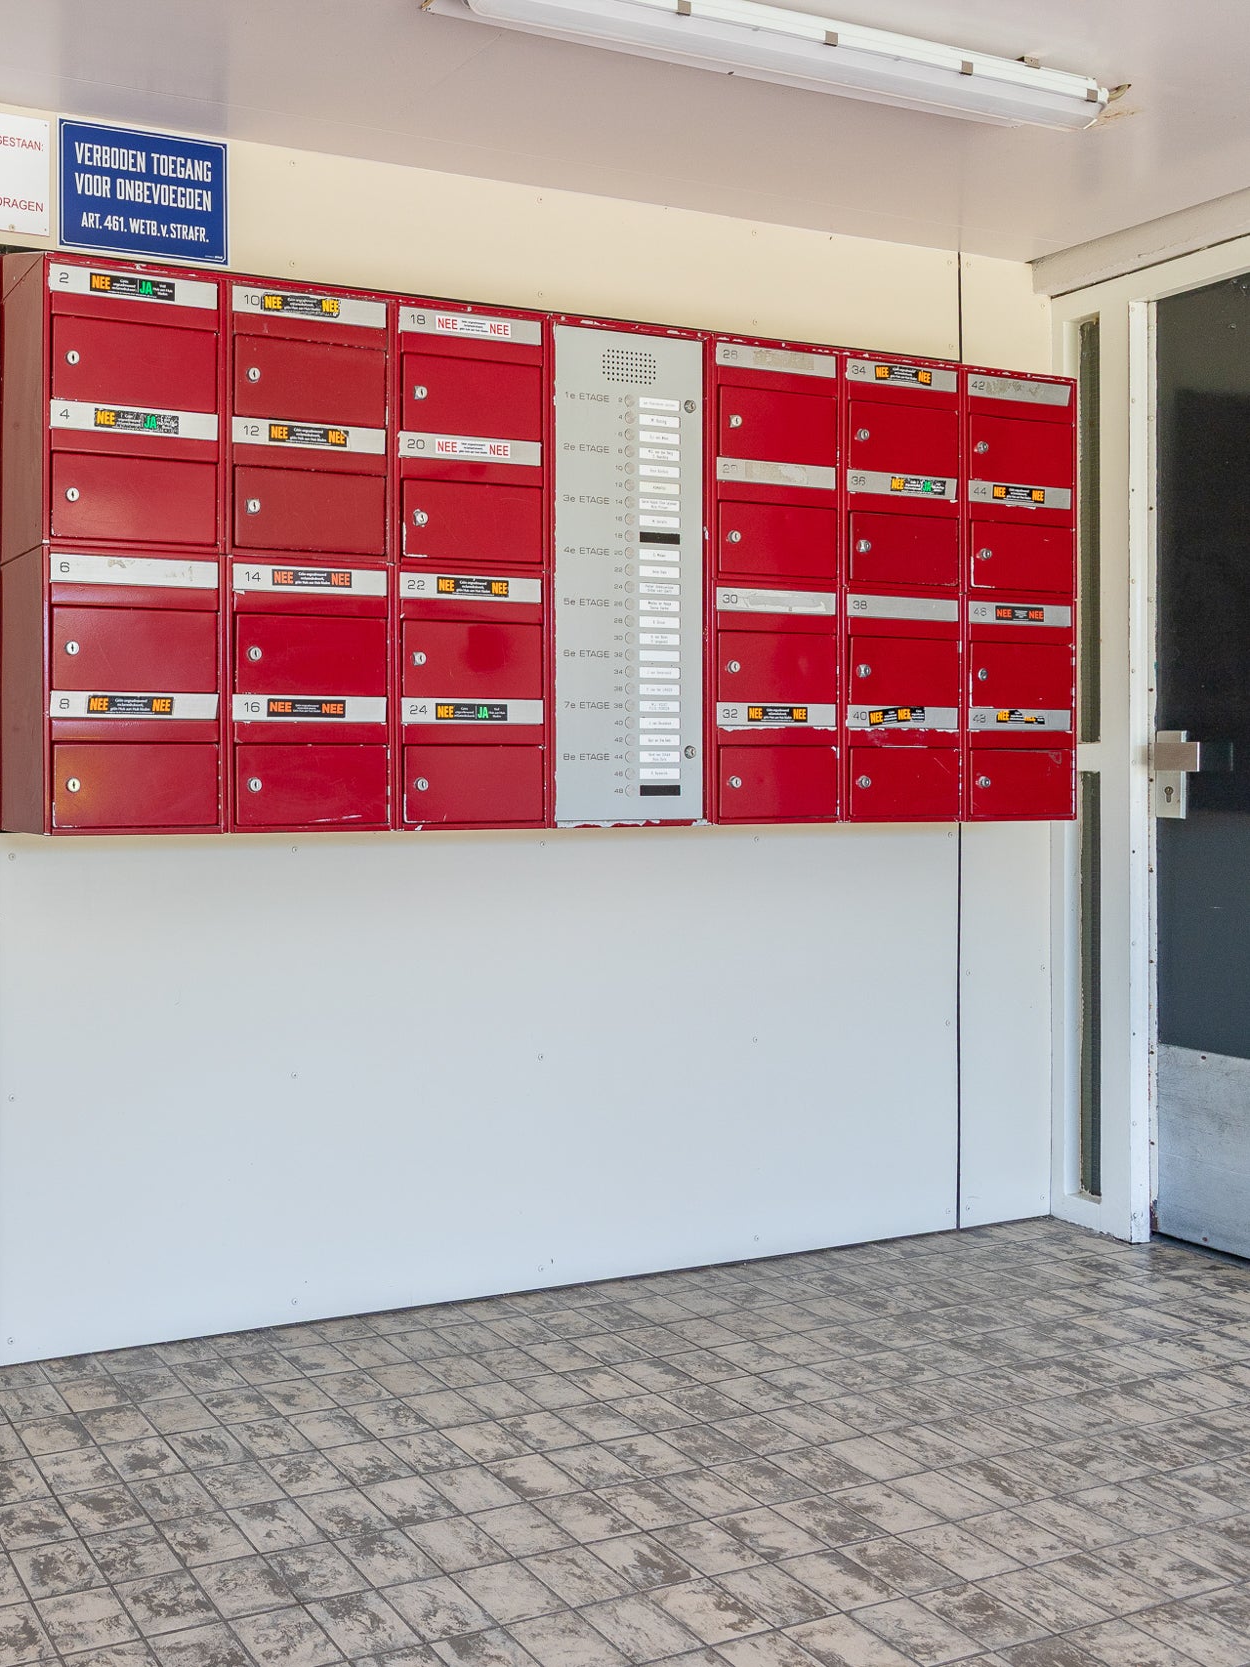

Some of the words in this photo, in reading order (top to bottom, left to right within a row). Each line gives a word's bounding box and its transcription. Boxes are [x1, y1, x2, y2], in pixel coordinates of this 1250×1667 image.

[74, 141, 146, 173] VERBODEN
[151, 153, 212, 182] TOEGANG
[74, 172, 111, 198] VOOR
[116, 179, 212, 212] ONBEVOEGDEN
[81, 212, 102, 229] ART.
[104, 215, 127, 232] 461.
[59, 272, 69, 283] 2
[92, 275, 110, 289] NEE
[139, 281, 153, 295] JA
[244, 295, 260, 305] 10
[265, 296, 282, 309] NEE
[322, 300, 339, 313] NEE
[411, 314, 425, 324] 18
[438, 318, 458, 330] NEE
[490, 324, 509, 336] NEE
[852, 365, 866, 374] 34
[876, 367, 889, 377] NEE
[919, 371, 930, 383] NEE
[972, 381, 985, 390] 42
[579, 393, 610, 402] ETAGE
[60, 409, 69, 419] 4
[96, 411, 115, 425] NEE
[144, 416, 157, 429] JA
[244, 425, 259, 436] 12
[271, 426, 288, 439] NEE
[329, 431, 345, 444] NEE
[407, 439, 425, 449] 20
[438, 441, 458, 452] NEE
[490, 444, 509, 456] NEE
[580, 444, 610, 453] ETAGE
[851, 476, 865, 486] 36
[892, 478, 904, 489] NEE
[922, 481, 932, 492] JA
[974, 487, 986, 495] 44
[994, 487, 1005, 497] NEE
[1032, 490, 1044, 501] NEE
[580, 496, 610, 504] ETAGE
[580, 547, 610, 556] ETAGE
[60, 562, 69, 572] 6
[246, 572, 261, 582] 14
[274, 572, 292, 583] NEE
[332, 574, 350, 585] NEE
[408, 580, 425, 590] 22
[439, 579, 454, 591] NEE
[492, 582, 507, 594] NEE
[580, 599, 610, 607] ETAGE
[723, 594, 738, 604] 30
[853, 600, 867, 609] 38
[996, 608, 1012, 618] NEE
[1028, 610, 1044, 620] NEE
[580, 650, 610, 658] ETAGE
[59, 699, 69, 709] 8
[90, 698, 108, 710] NEE
[152, 699, 171, 711] NEE
[244, 702, 260, 712] 16
[270, 702, 291, 712] NEE
[322, 704, 343, 714] NEE
[410, 705, 427, 714] 24
[438, 706, 454, 717] NEE
[478, 707, 488, 718] JA
[723, 709, 737, 718] 32
[749, 708, 762, 719] NEE
[793, 709, 806, 719] NEE
[853, 712, 867, 720] 40
[870, 712, 883, 723] NEE
